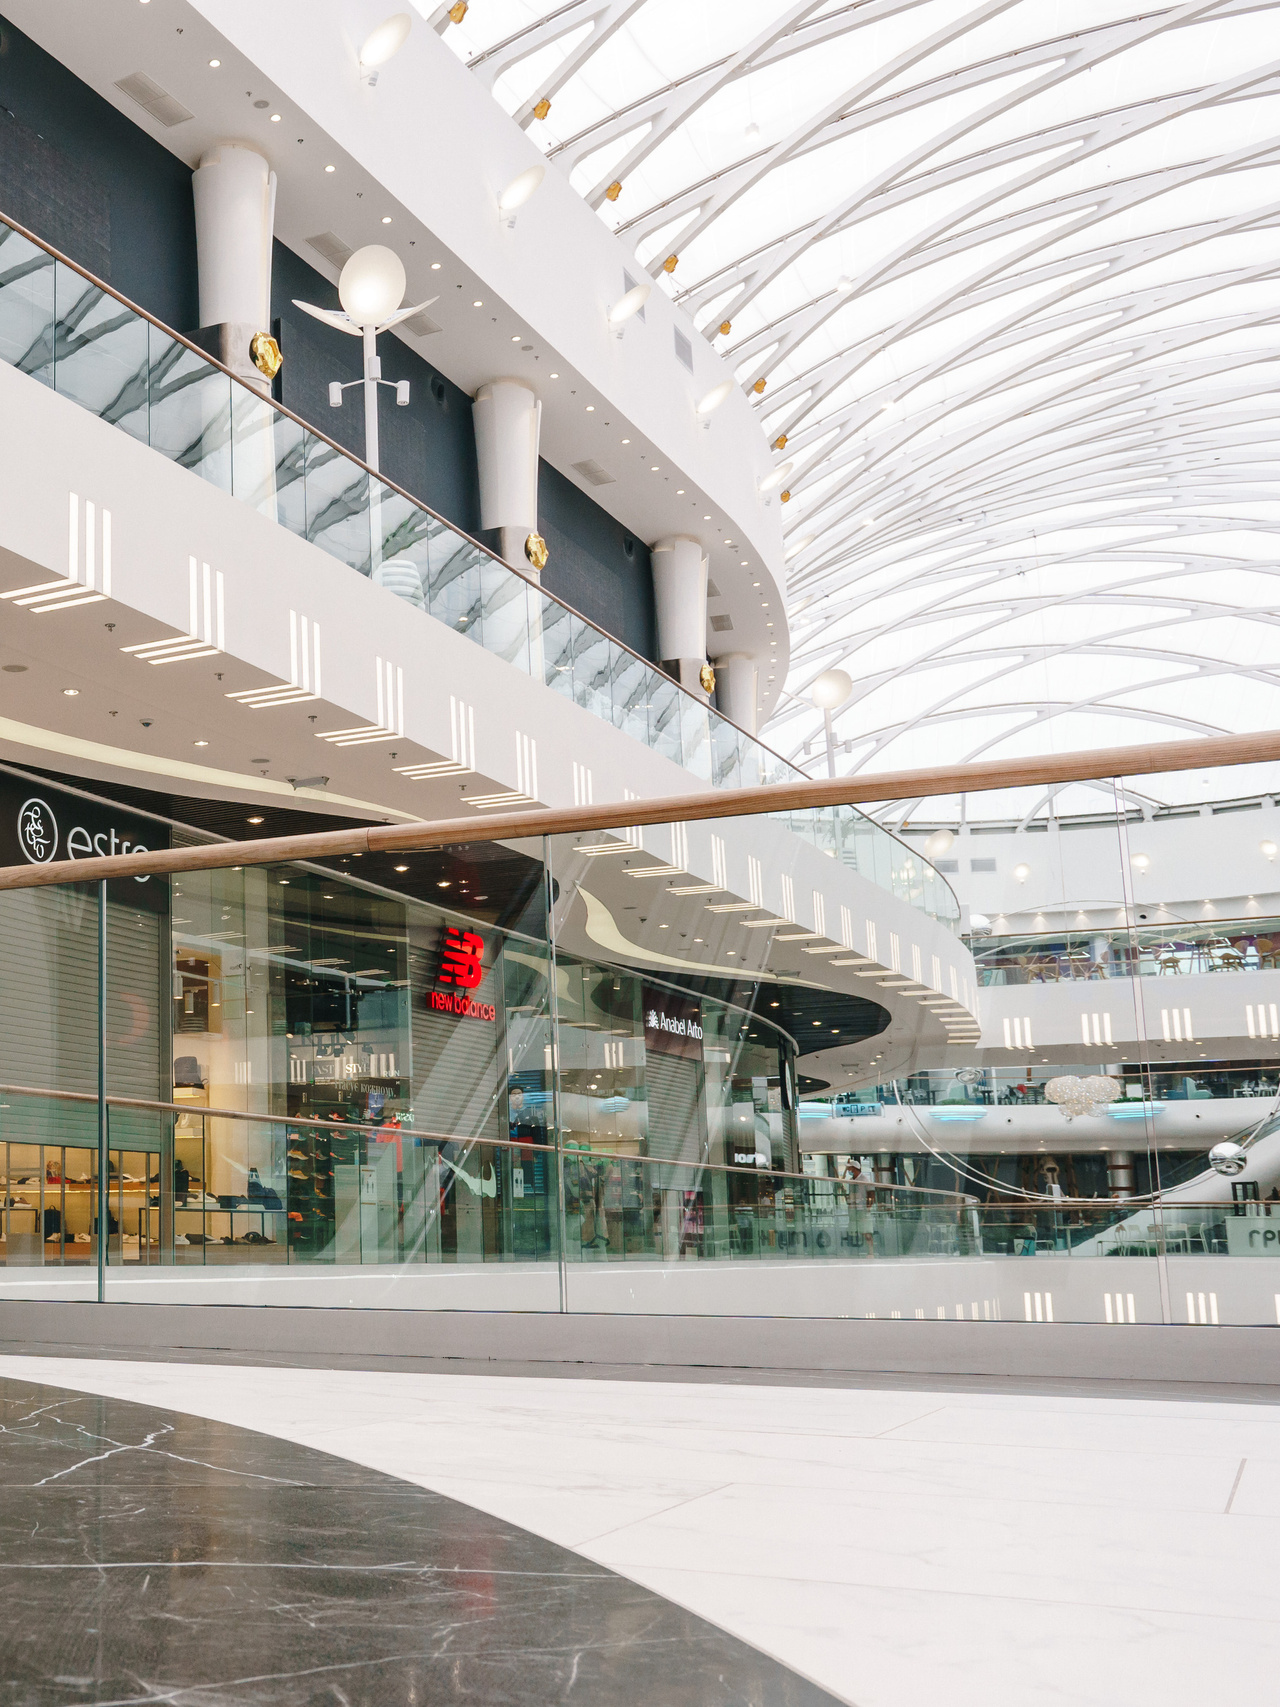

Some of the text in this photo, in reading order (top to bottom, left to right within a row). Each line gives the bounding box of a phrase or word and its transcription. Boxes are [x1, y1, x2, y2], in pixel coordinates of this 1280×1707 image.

[430, 991, 496, 1021] new balance
[660, 1011, 703, 1040] Anabel Arto
